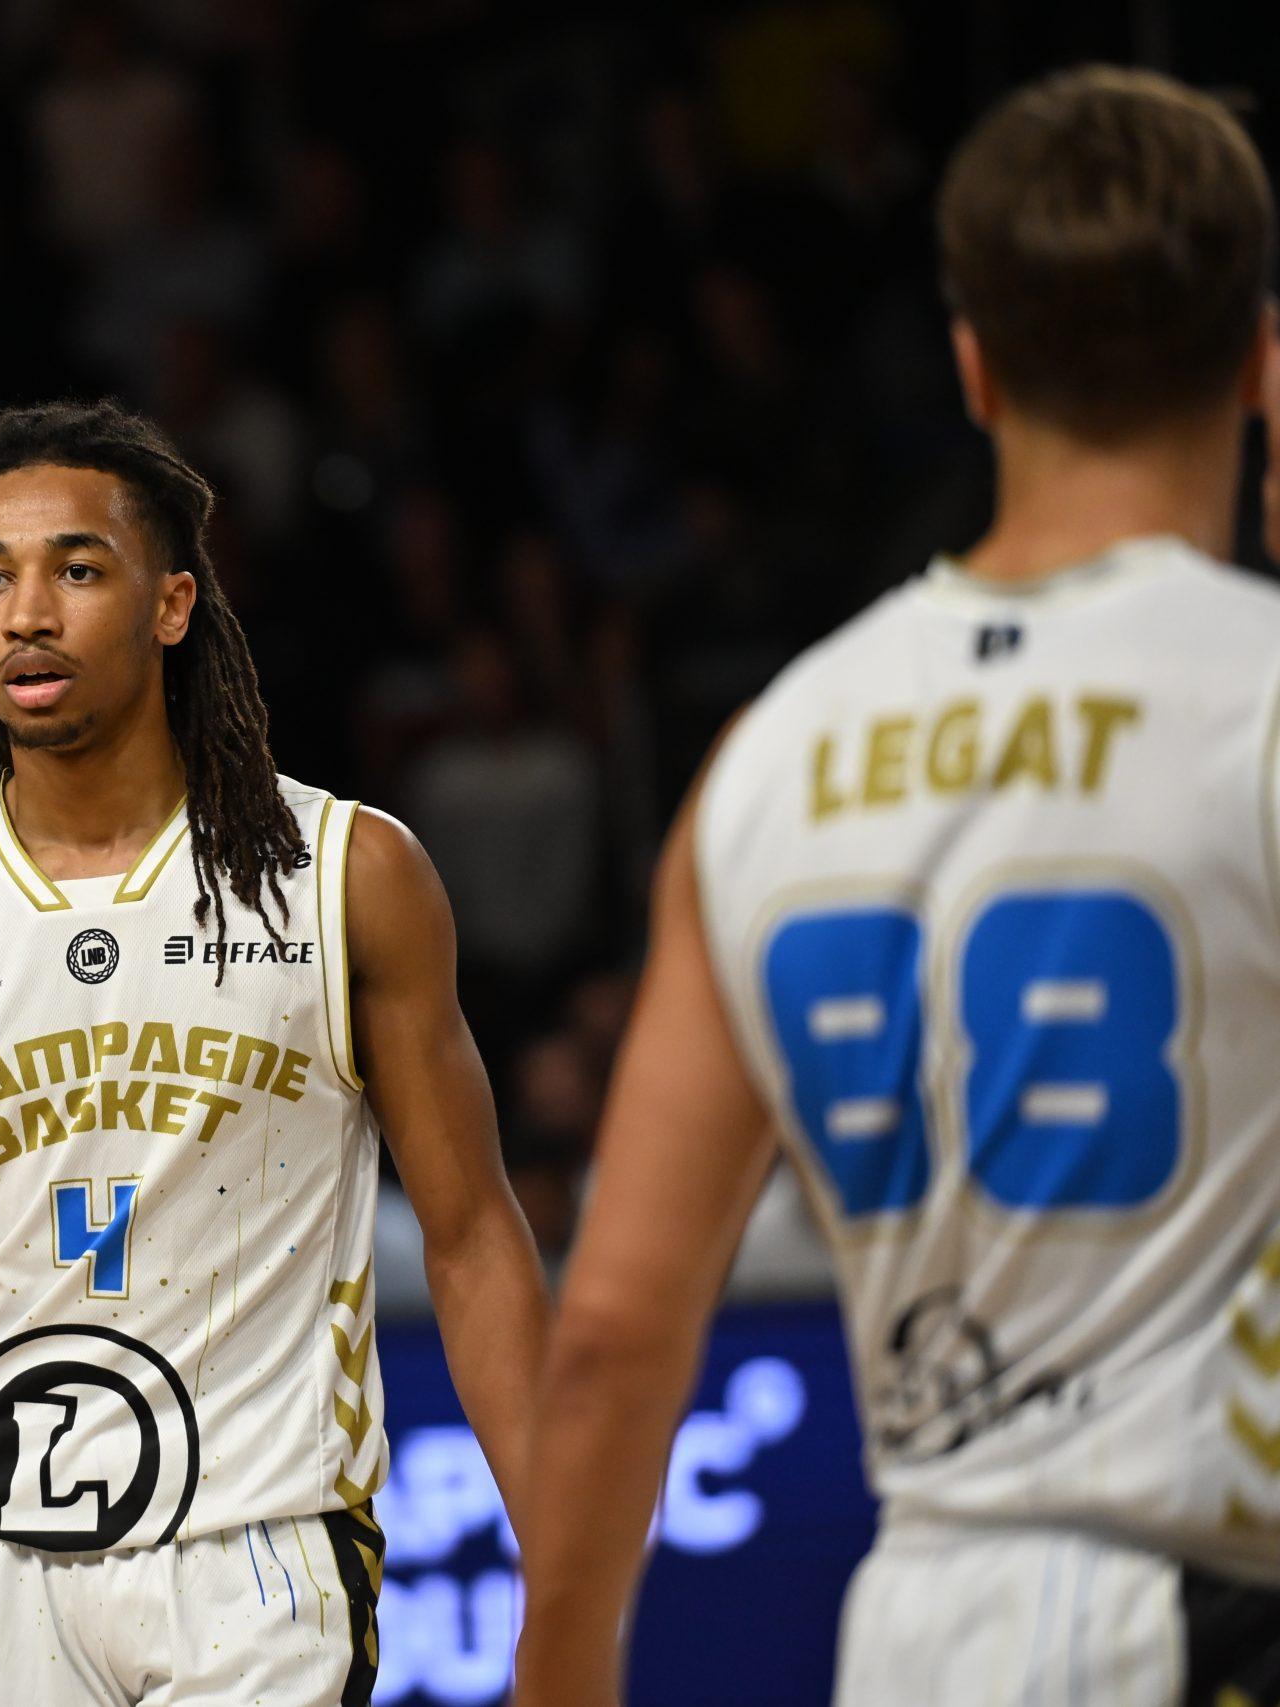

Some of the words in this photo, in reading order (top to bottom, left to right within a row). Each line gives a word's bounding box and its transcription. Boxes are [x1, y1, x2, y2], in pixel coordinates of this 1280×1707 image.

[807, 690, 1144, 828] LEGAT
[81, 946, 107, 967] LNB
[203, 942, 315, 964] EIFFAGE
[742, 862, 1206, 1240] 88
[48, 1174, 144, 1300] 4
